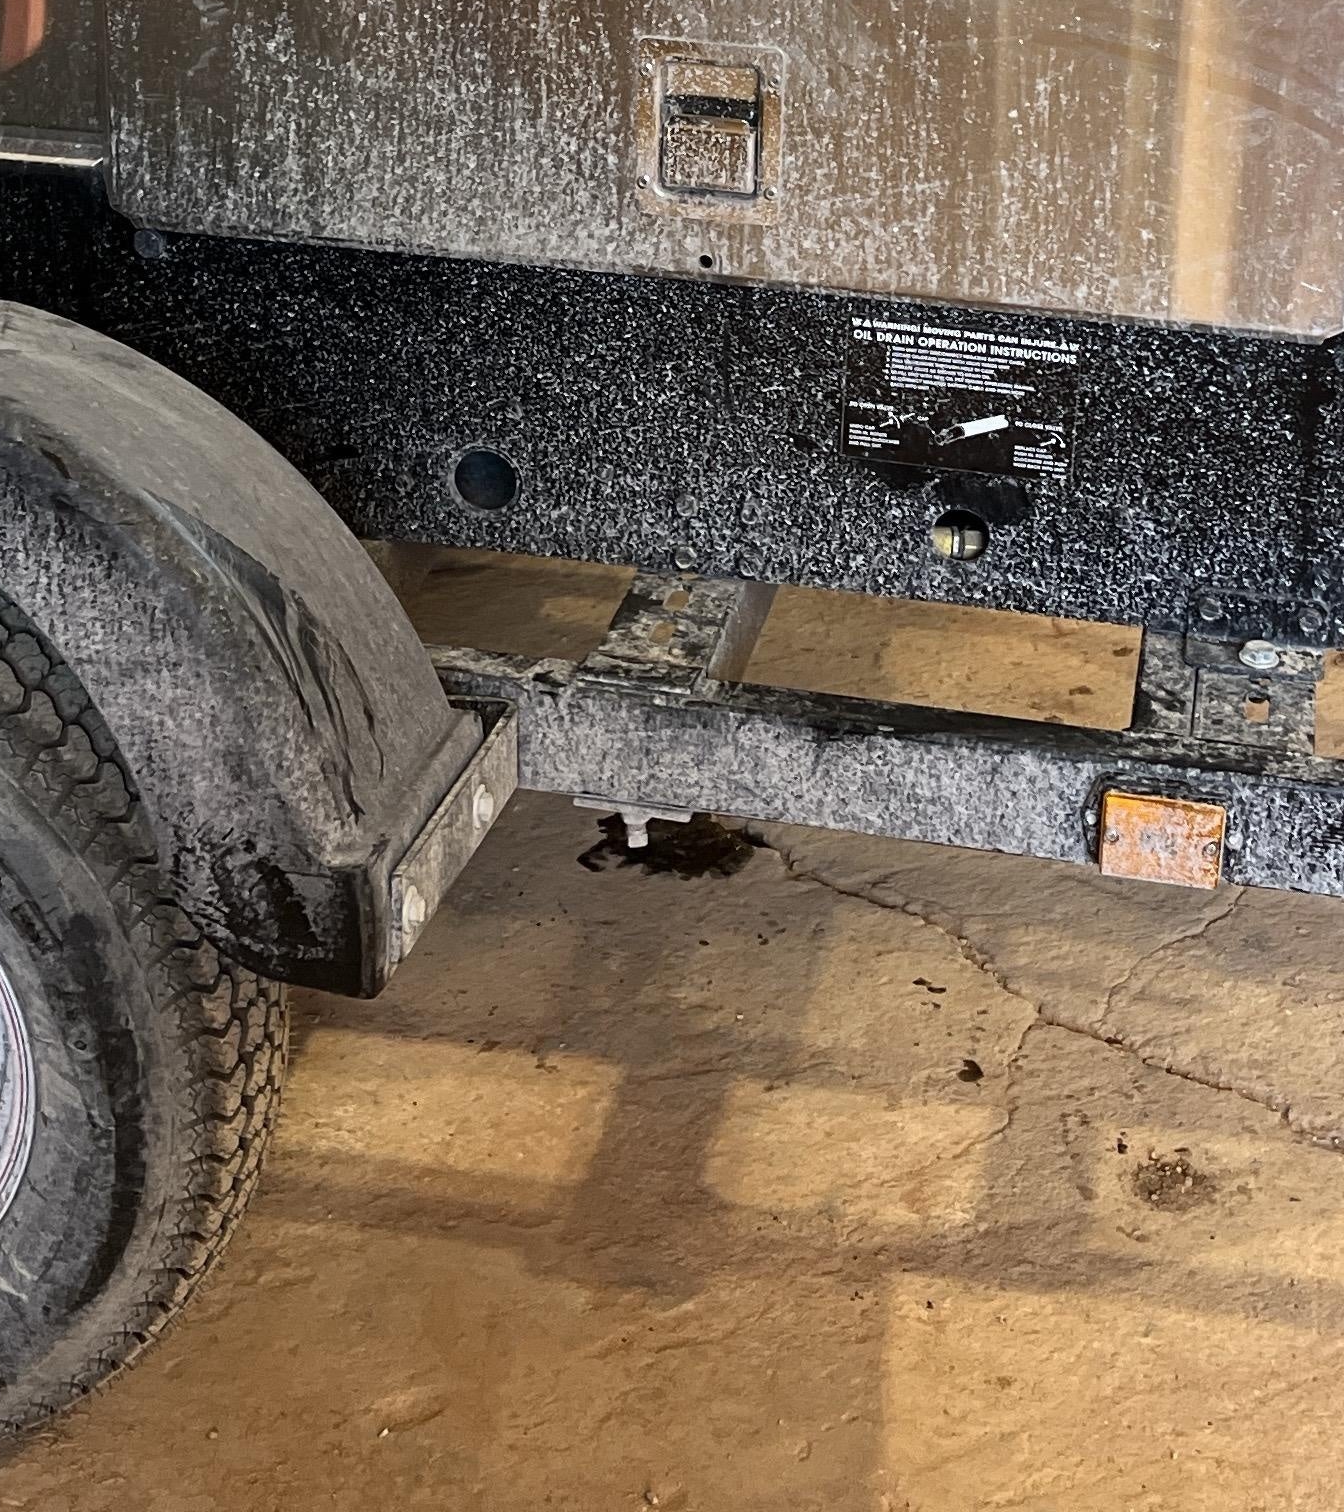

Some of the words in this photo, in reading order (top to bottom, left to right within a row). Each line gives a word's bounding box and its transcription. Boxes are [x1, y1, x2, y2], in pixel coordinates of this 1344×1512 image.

[853, 329, 873, 341] OIL
[876, 331, 915, 346] DRAIN
[917, 336, 987, 354] OPERATION
[990, 344, 1078, 365] INSTRUCTIONS
